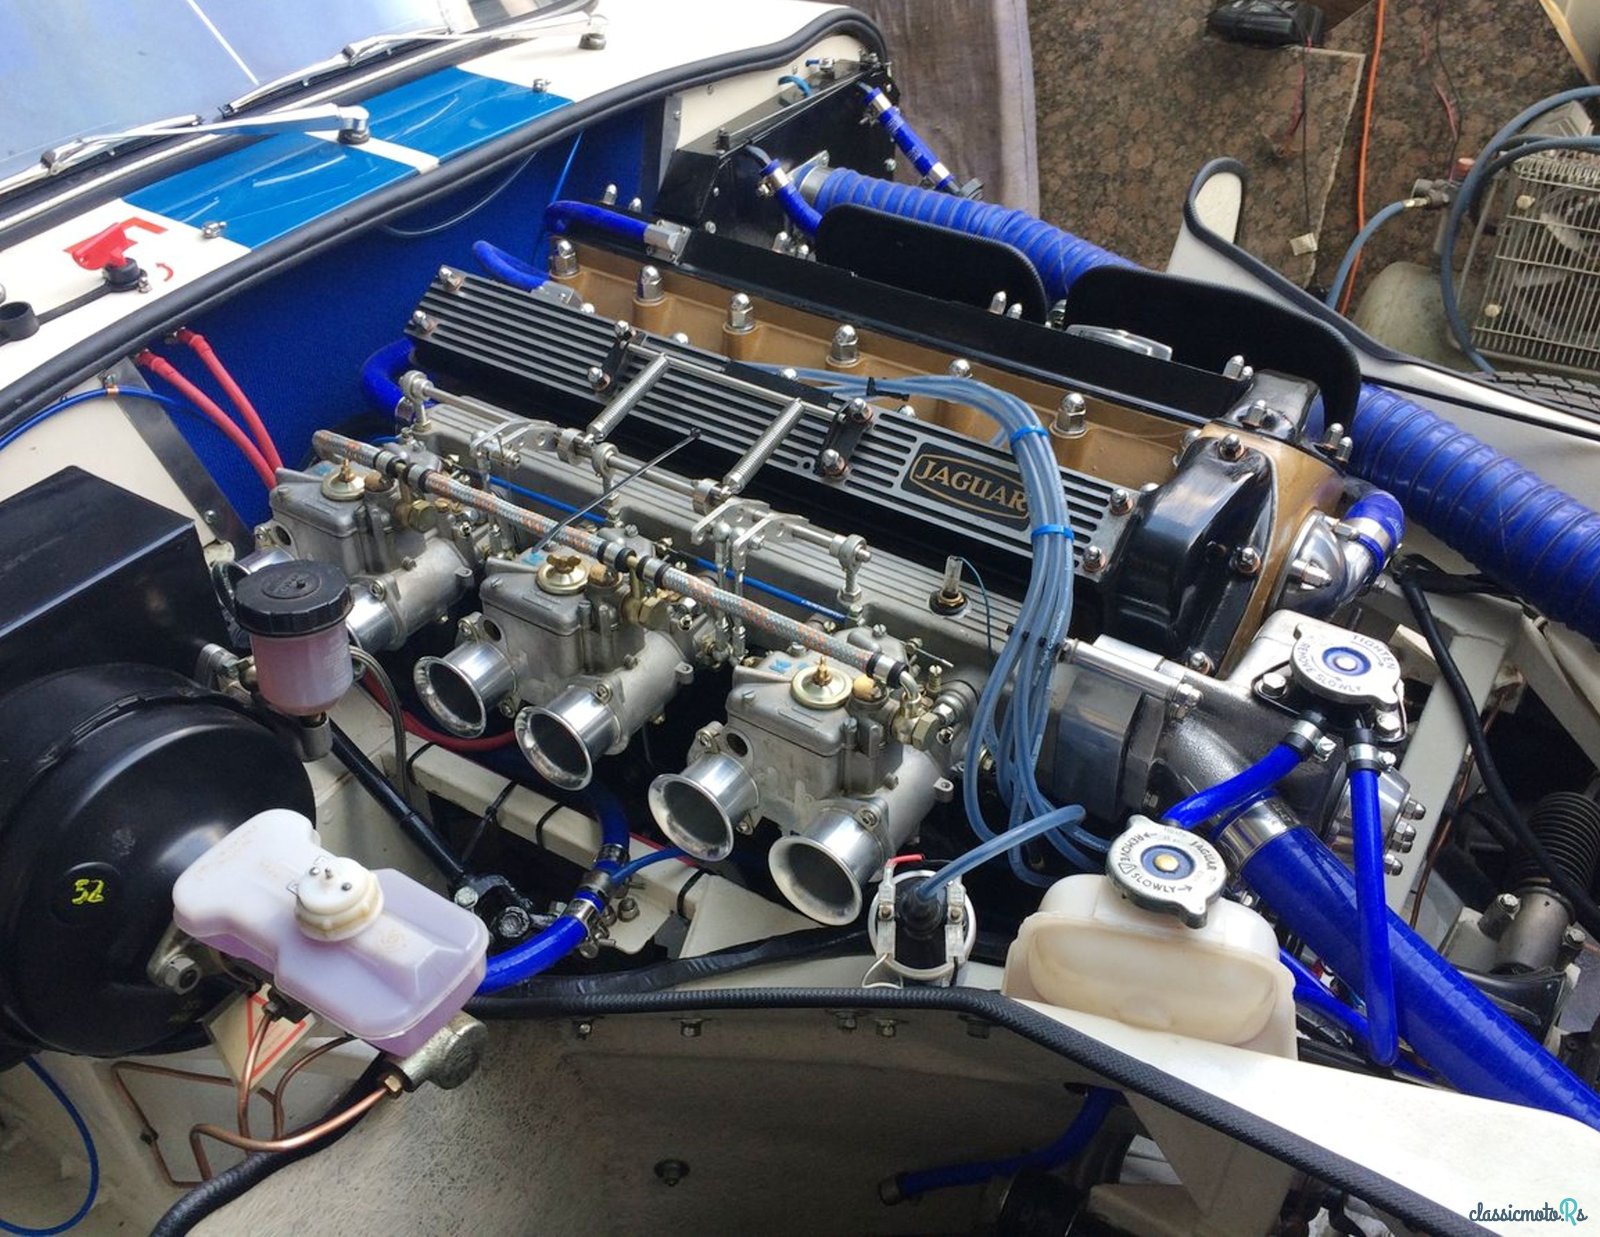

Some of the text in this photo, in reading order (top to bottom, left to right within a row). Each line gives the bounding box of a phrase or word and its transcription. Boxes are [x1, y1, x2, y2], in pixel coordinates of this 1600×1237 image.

[914, 460, 1027, 512] JAGUAR
[1297, 642, 1361, 692] REMOVE SLOWLY
[1352, 634, 1396, 670] TIGHTEN
[1120, 833, 1144, 862] REMOVE
[1190, 840, 1217, 871] JAGUAR
[1131, 872, 1176, 893] SLOWLY
